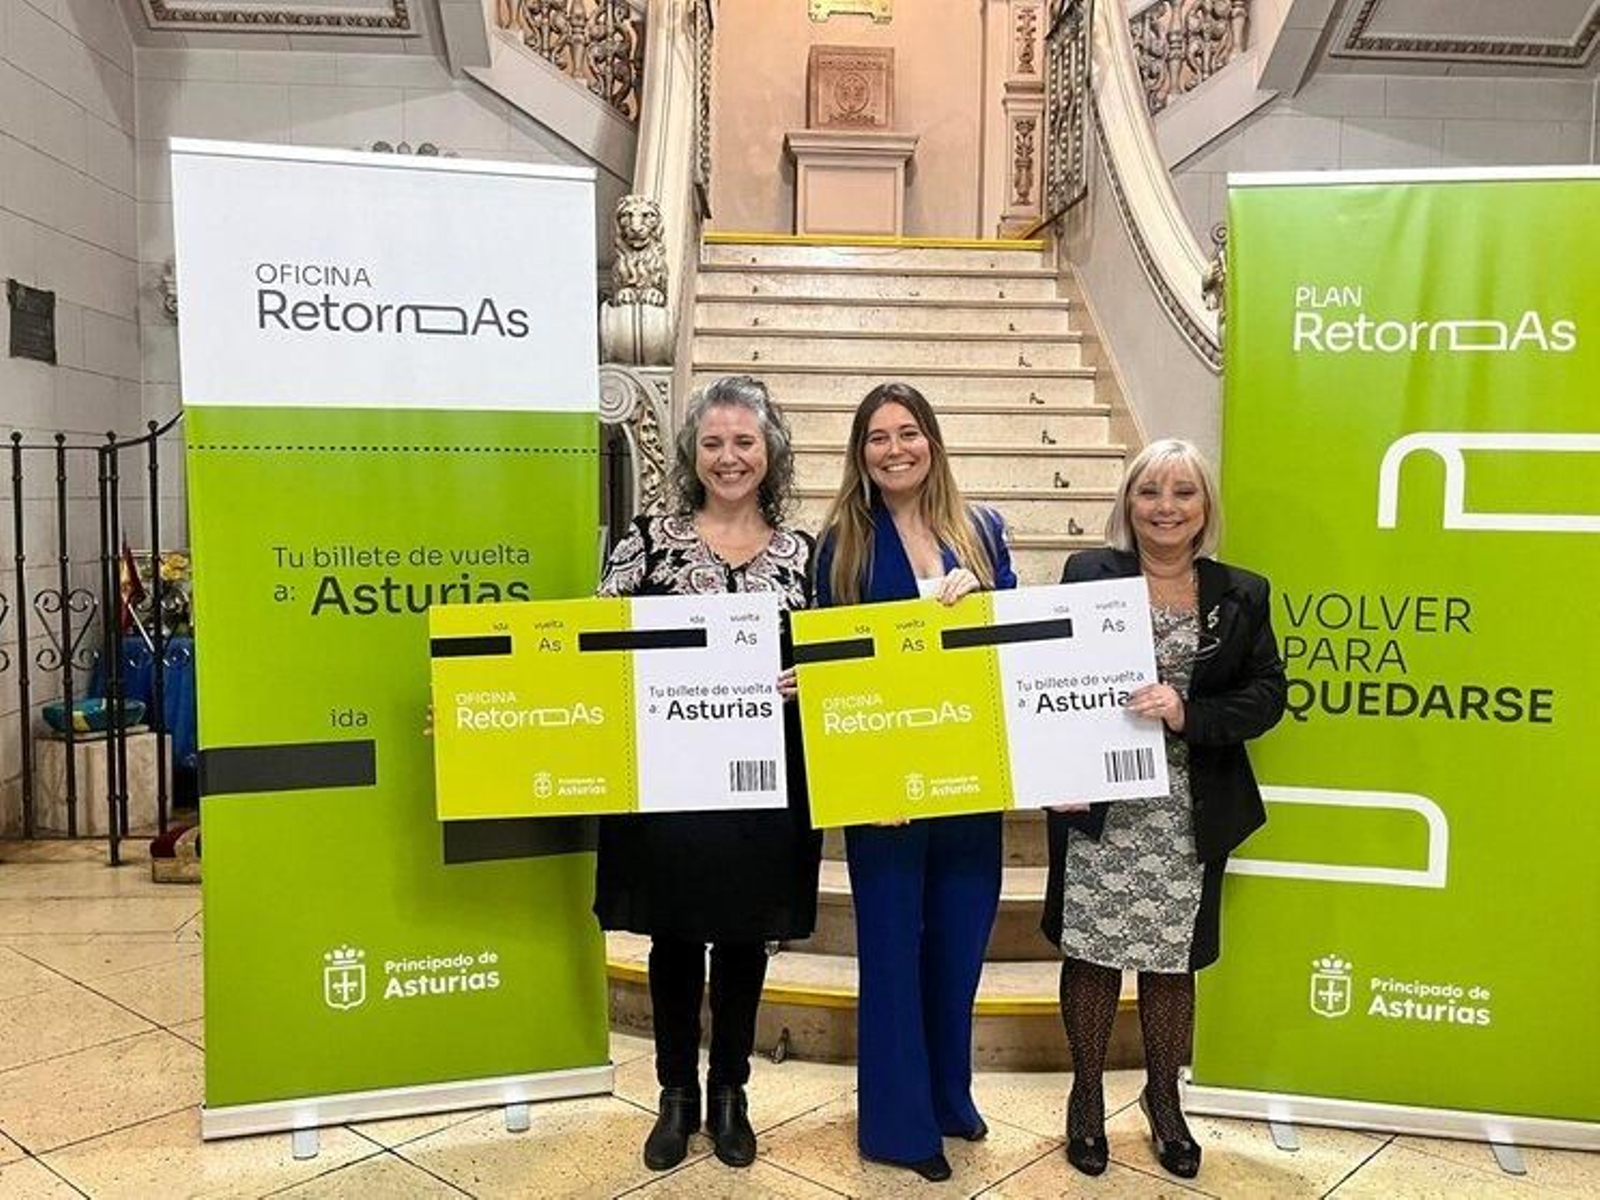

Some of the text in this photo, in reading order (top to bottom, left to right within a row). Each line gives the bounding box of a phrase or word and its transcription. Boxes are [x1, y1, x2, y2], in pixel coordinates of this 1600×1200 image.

[256, 263, 371, 288] OFICINA
[1295, 286, 1362, 309] PLAN
[273, 544, 530, 568] Tu billete de vuelta
[274, 584, 295, 602] a:
[1283, 593, 1472, 633] VOLVER
[1102, 618, 1126, 633] As
[539, 637, 562, 652] As
[734, 629, 758, 646] As
[902, 637, 926, 652] As
[1284, 636, 1407, 674] PARA
[649, 683, 772, 698] Tu billete de vuelta
[1016, 670, 1144, 692] Tu billete de vuelta
[455, 690, 517, 705] OFICINA
[666, 697, 773, 720] Asturias
[822, 693, 882, 710] OFICINA
[1035, 687, 1130, 714] Asturia
[1284, 678, 1554, 723] QUEDARSE
[330, 708, 368, 727] ida
[384, 951, 499, 975] Principado de
[383, 968, 501, 999] Asturias
[1370, 977, 1490, 1001] Principado de
[1366, 994, 1491, 1026] Asturias
